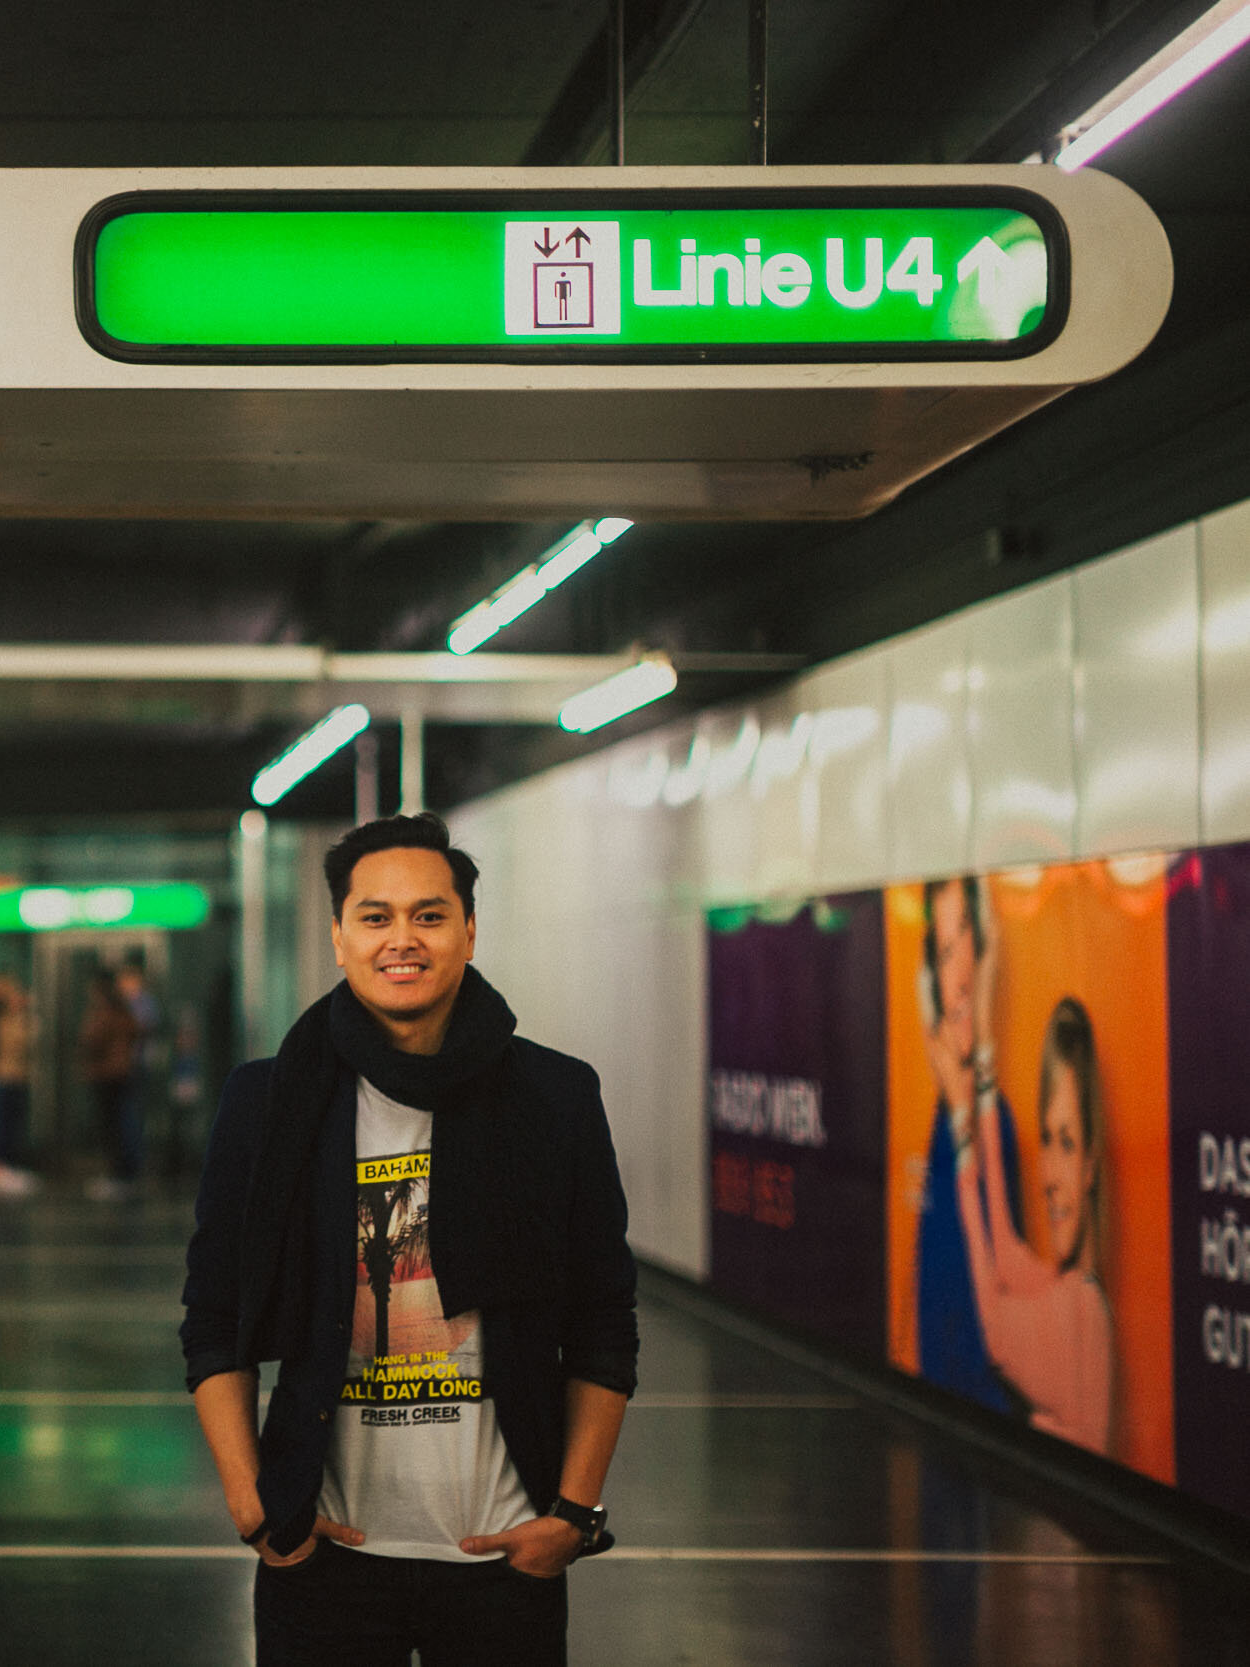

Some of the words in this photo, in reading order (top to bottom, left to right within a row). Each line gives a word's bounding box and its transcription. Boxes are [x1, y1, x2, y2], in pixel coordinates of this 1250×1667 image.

[633, 238, 812, 306] Linie
[826, 237, 943, 308] U4
[374, 1354, 406, 1366] HANG
[410, 1353, 422, 1363] IN
[425, 1350, 448, 1362] THE
[362, 1363, 459, 1383] HAMMOCK
[341, 1383, 377, 1400] ALL
[383, 1382, 422, 1400] DAY
[429, 1380, 481, 1397] LONG
[361, 1408, 407, 1421] FRESH
[412, 1406, 460, 1419] CREEK
